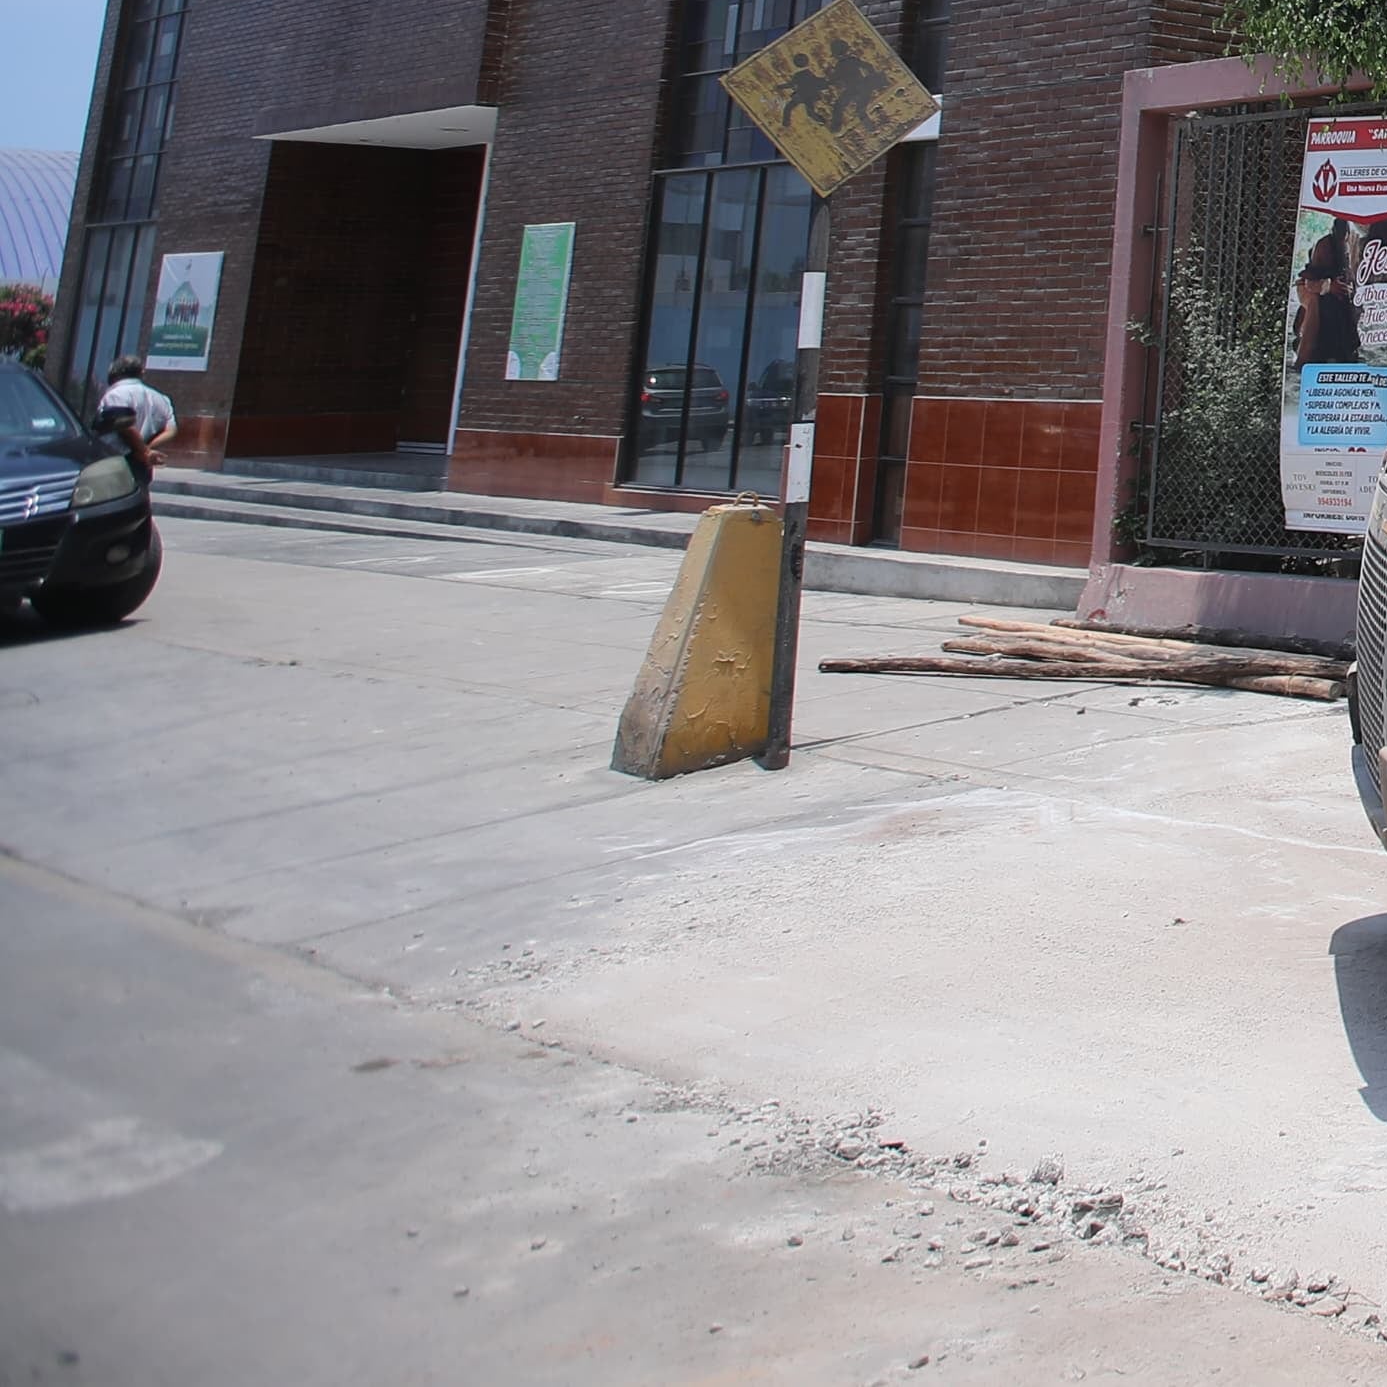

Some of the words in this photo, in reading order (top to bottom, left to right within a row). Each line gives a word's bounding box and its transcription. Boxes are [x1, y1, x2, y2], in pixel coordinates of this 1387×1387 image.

[1311, 130, 1356, 145] PARROQUIA
[1340, 168, 1370, 177] TALLERES
[1371, 168, 1379, 176] DE
[1358, 184, 1375, 192] Nueva
[1318, 373, 1334, 383] ESTE
[1334, 373, 1359, 383] TALLER
[1358, 373, 1367, 383] TE
[1335, 400, 1369, 410] COMPLEJOS
[1341, 413, 1349, 422] LA
[1311, 426, 1319, 435] LA
[1319, 424, 1344, 435] ALEGRÍA
[1345, 426, 1354, 435] DE
